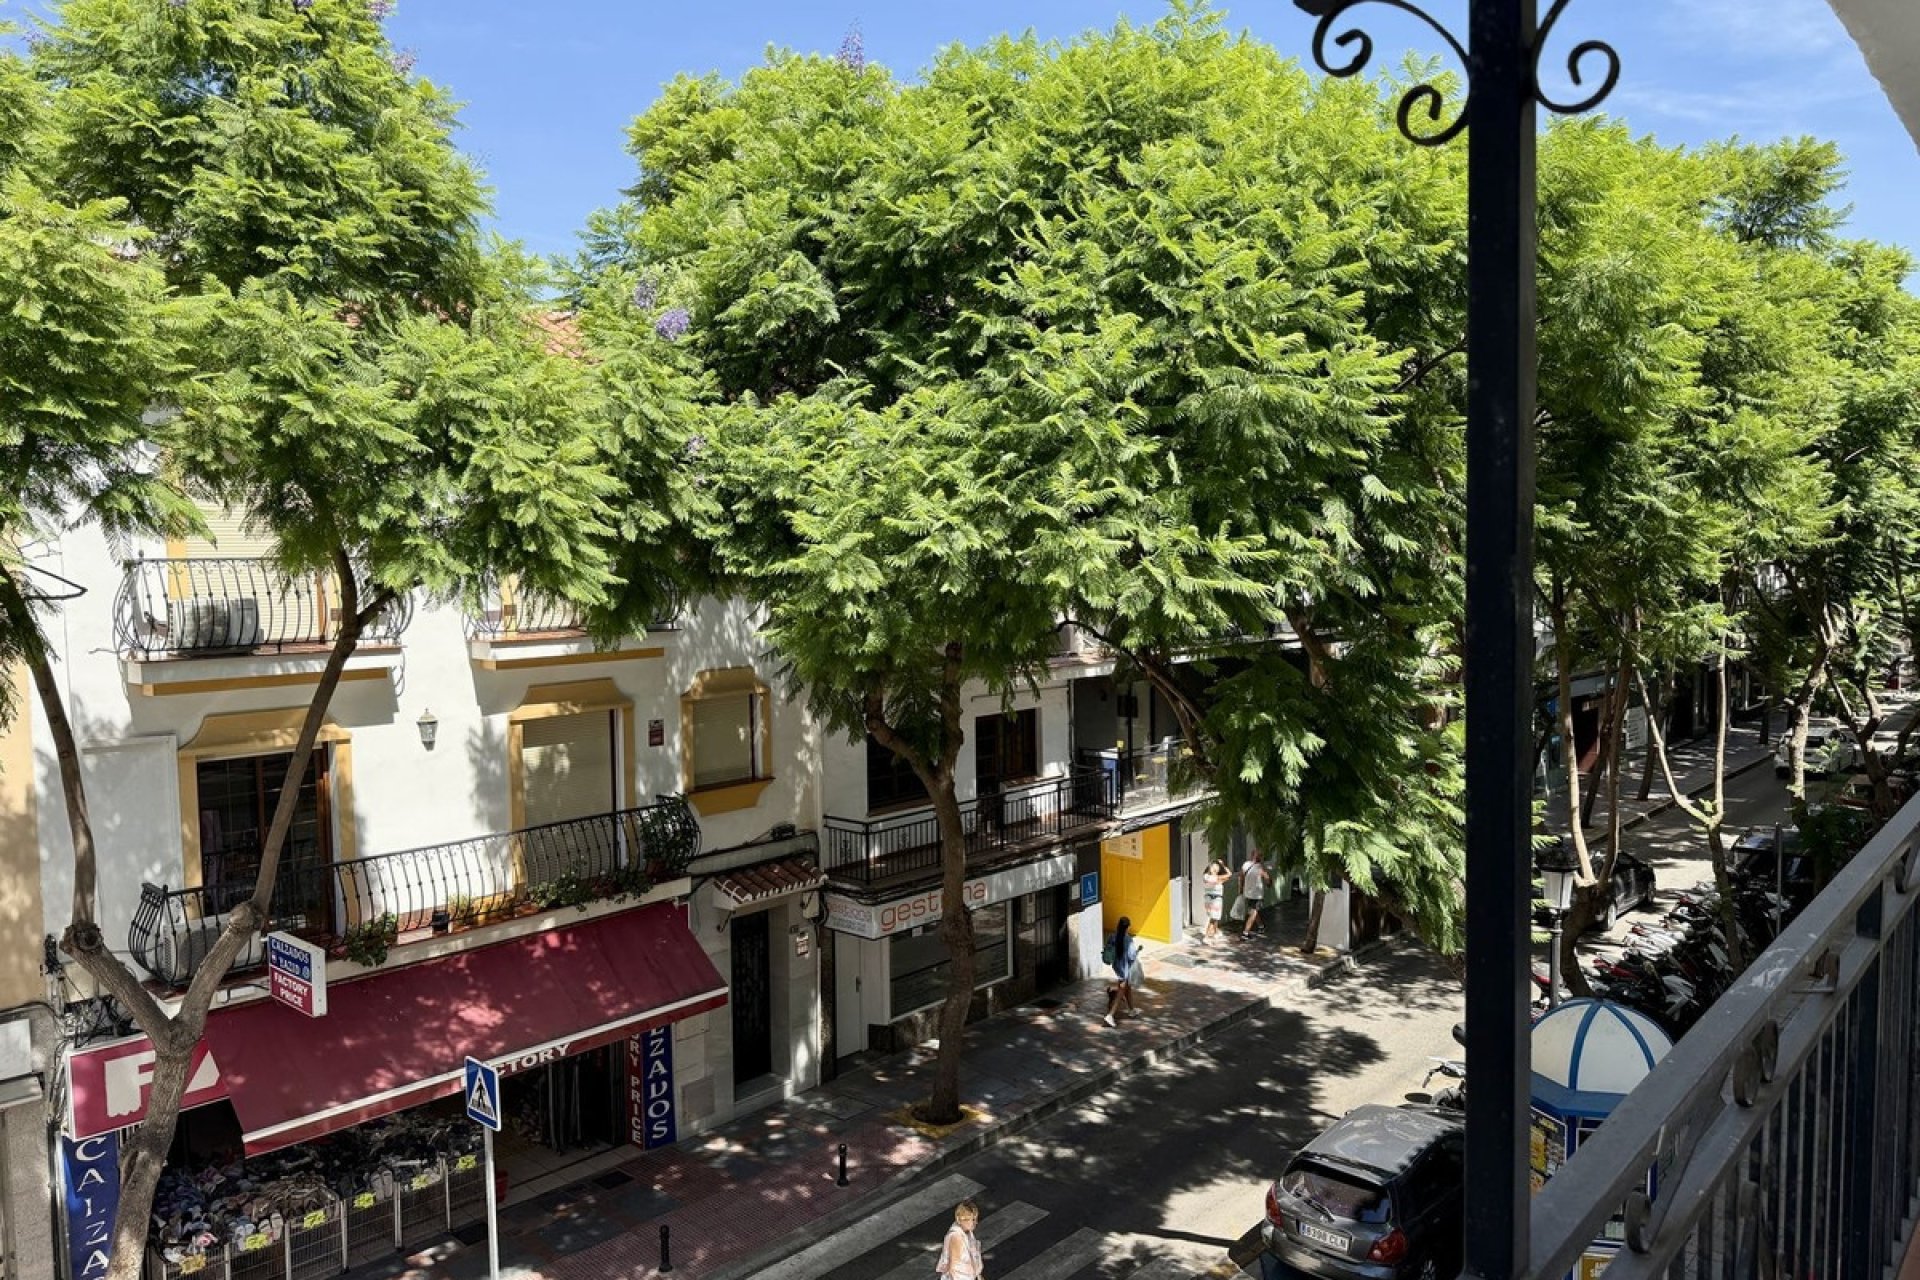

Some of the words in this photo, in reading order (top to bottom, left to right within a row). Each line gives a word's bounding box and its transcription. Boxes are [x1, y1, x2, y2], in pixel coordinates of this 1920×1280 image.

[880, 880, 986, 932] gestna
[274, 972, 309, 997] FACTORY
[280, 987, 304, 1008] PRICE
[631, 1075, 642, 1145] PRICE
